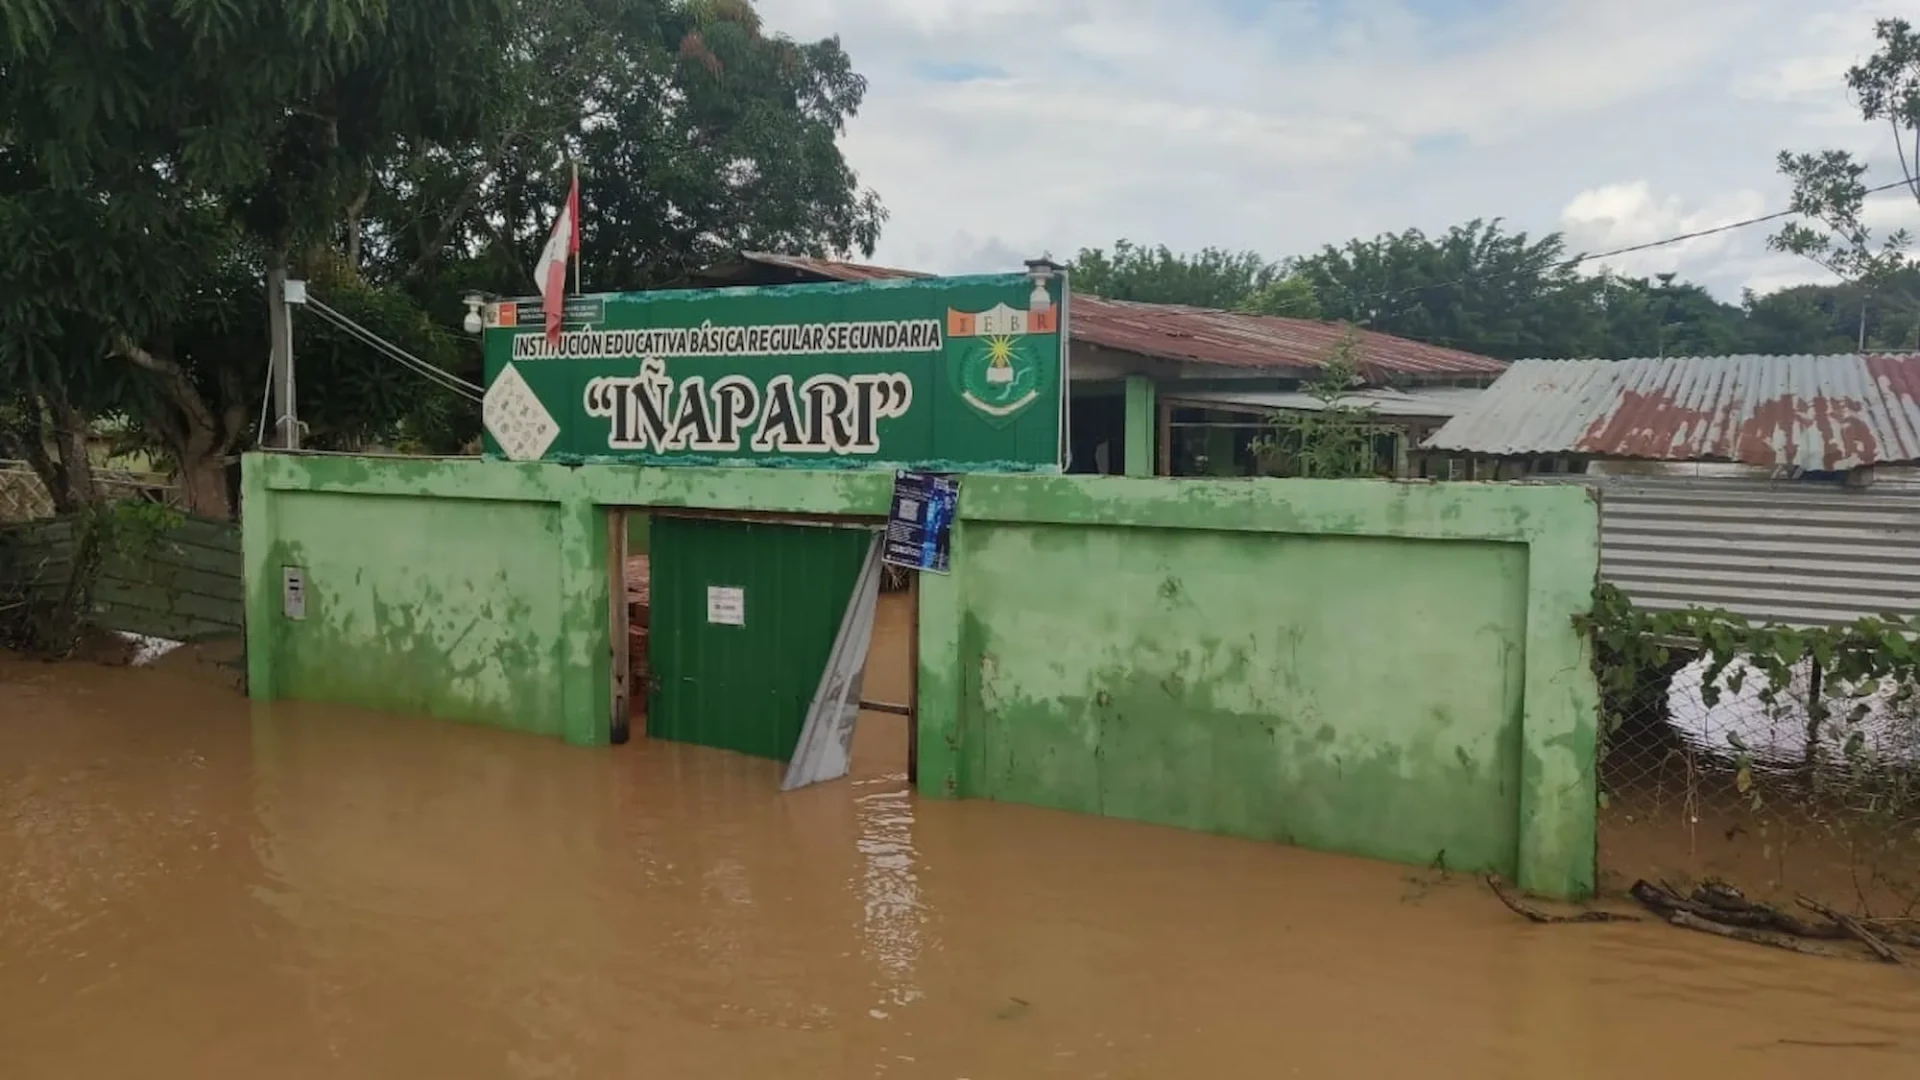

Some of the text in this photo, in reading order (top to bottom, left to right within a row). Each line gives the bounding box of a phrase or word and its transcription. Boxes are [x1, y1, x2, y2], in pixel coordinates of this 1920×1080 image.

[960, 313, 1048, 332] I E B R
[605, 331, 688, 354] EDUCATIVA
[690, 323, 746, 352] BÁSICA
[749, 328, 825, 351] REGULAR
[827, 323, 940, 350] SECUNDARIA
